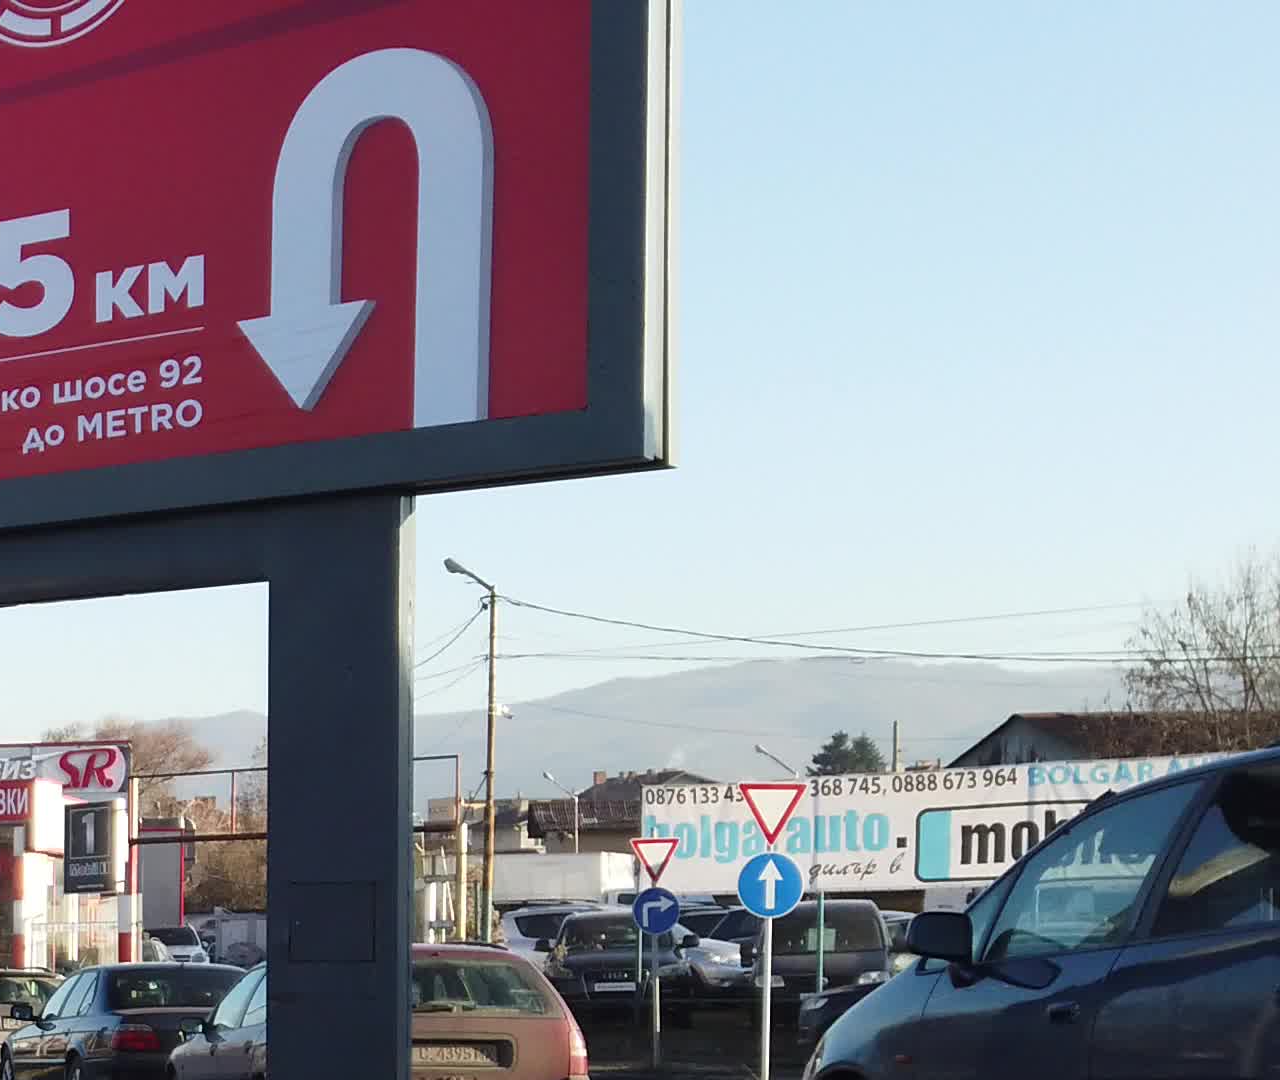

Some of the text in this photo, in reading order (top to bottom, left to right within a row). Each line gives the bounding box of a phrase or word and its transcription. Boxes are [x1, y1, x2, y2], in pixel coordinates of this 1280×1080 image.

[53, 367, 146, 405] шосе
[159, 355, 203, 388] 92
[22, 399, 204, 454] до METRO
[645, 767, 1017, 804] 0876 133 43 368 745, 0888 673 964
[1028, 760, 1154, 785] BOLGAR
